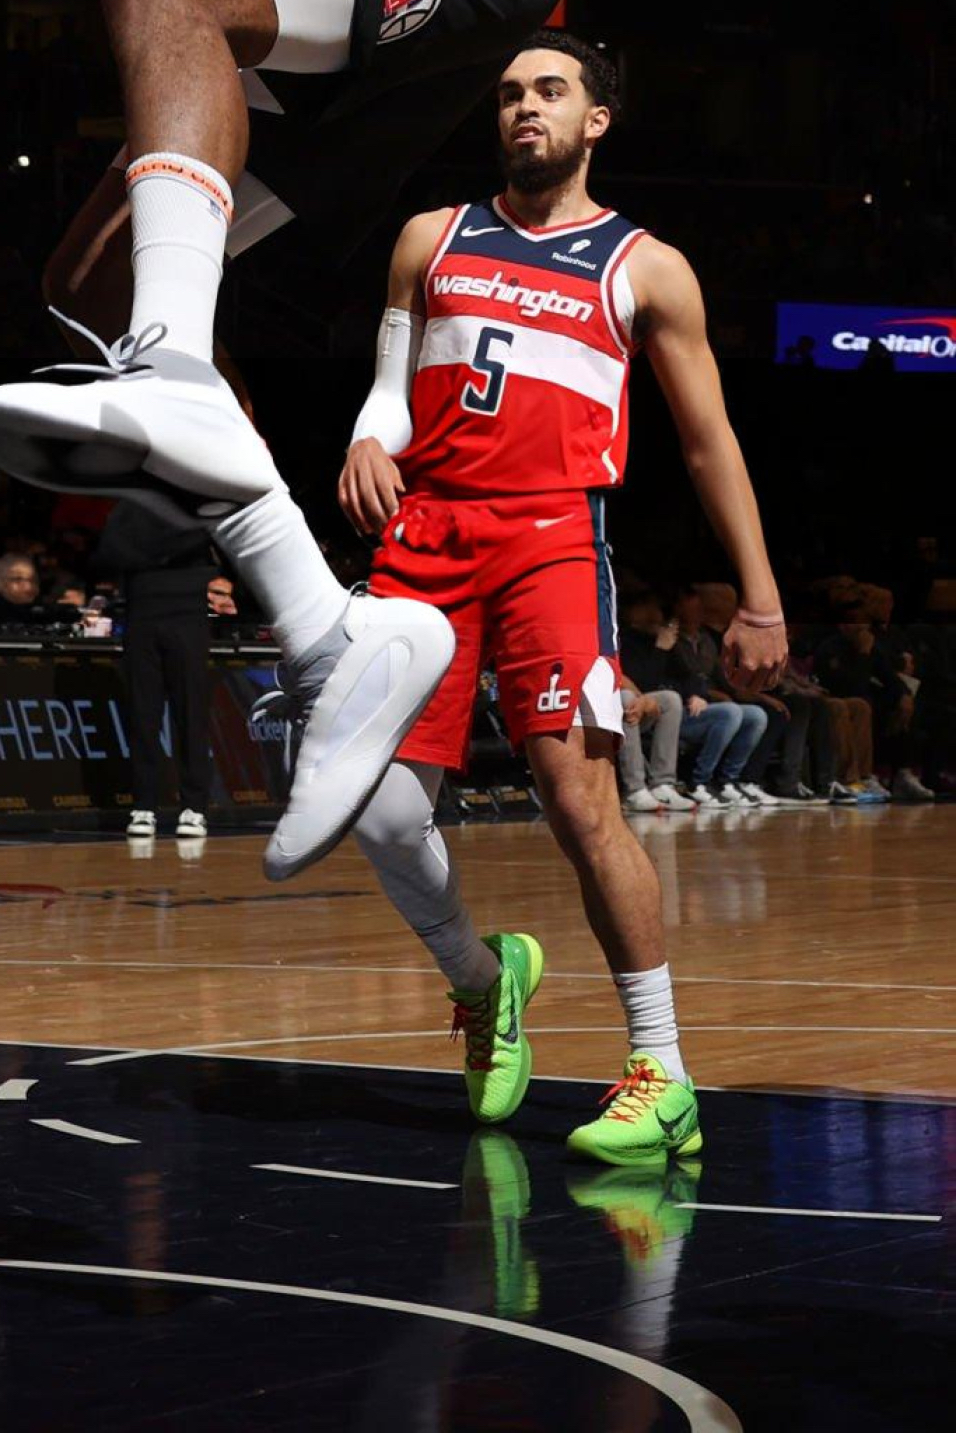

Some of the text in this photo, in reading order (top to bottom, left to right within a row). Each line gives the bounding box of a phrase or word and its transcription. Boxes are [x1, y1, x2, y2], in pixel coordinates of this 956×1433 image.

[551, 251, 597, 271] Robinhood
[433, 271, 594, 324] washington
[462, 326, 514, 416] 5
